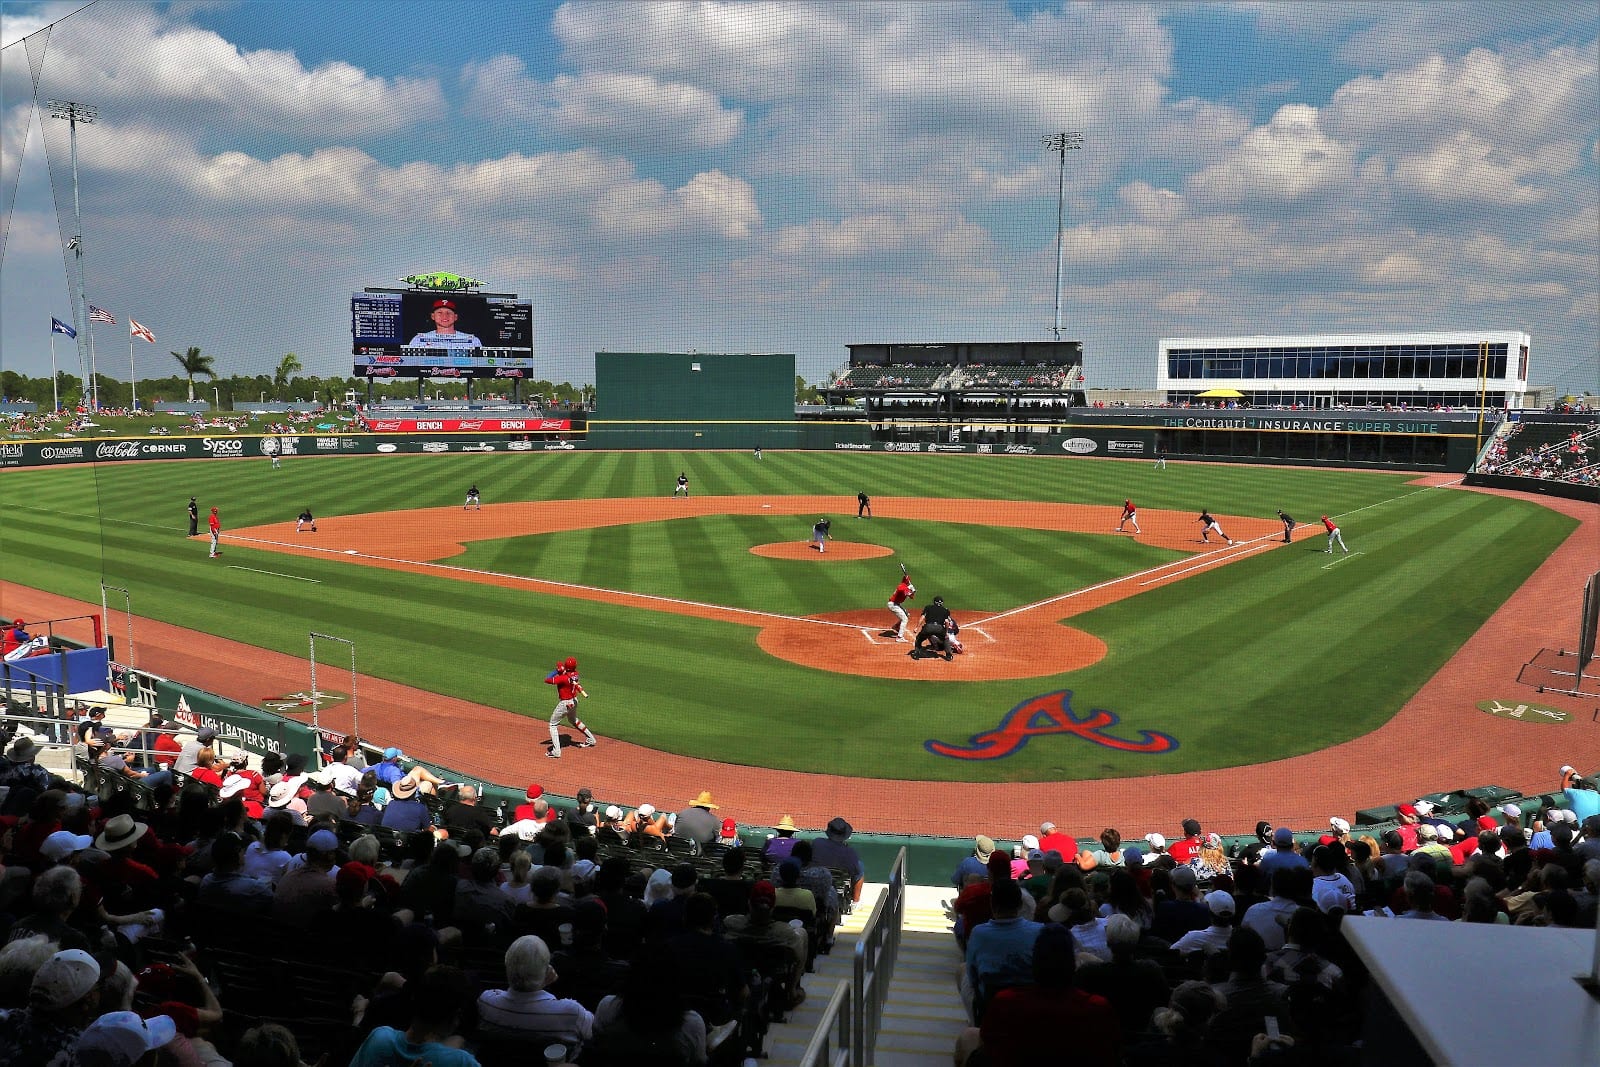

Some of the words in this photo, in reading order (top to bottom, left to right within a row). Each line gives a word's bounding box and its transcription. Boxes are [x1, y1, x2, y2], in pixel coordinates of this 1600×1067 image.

[416, 421, 443, 430] BENCH
[500, 421, 526, 430] BENCH
[1163, 418, 1184, 427] THE
[1186, 417, 1246, 428] Centauri
[1258, 421, 1341, 431] INSURANCE
[1347, 422, 1391, 432] SUPER
[1396, 423, 1438, 433] SUITE
[142, 445, 187, 453] CORNER
[202, 438, 242, 452] Sysco
[226, 724, 266, 749] BATTER'S
[266, 738, 286, 754] BO
